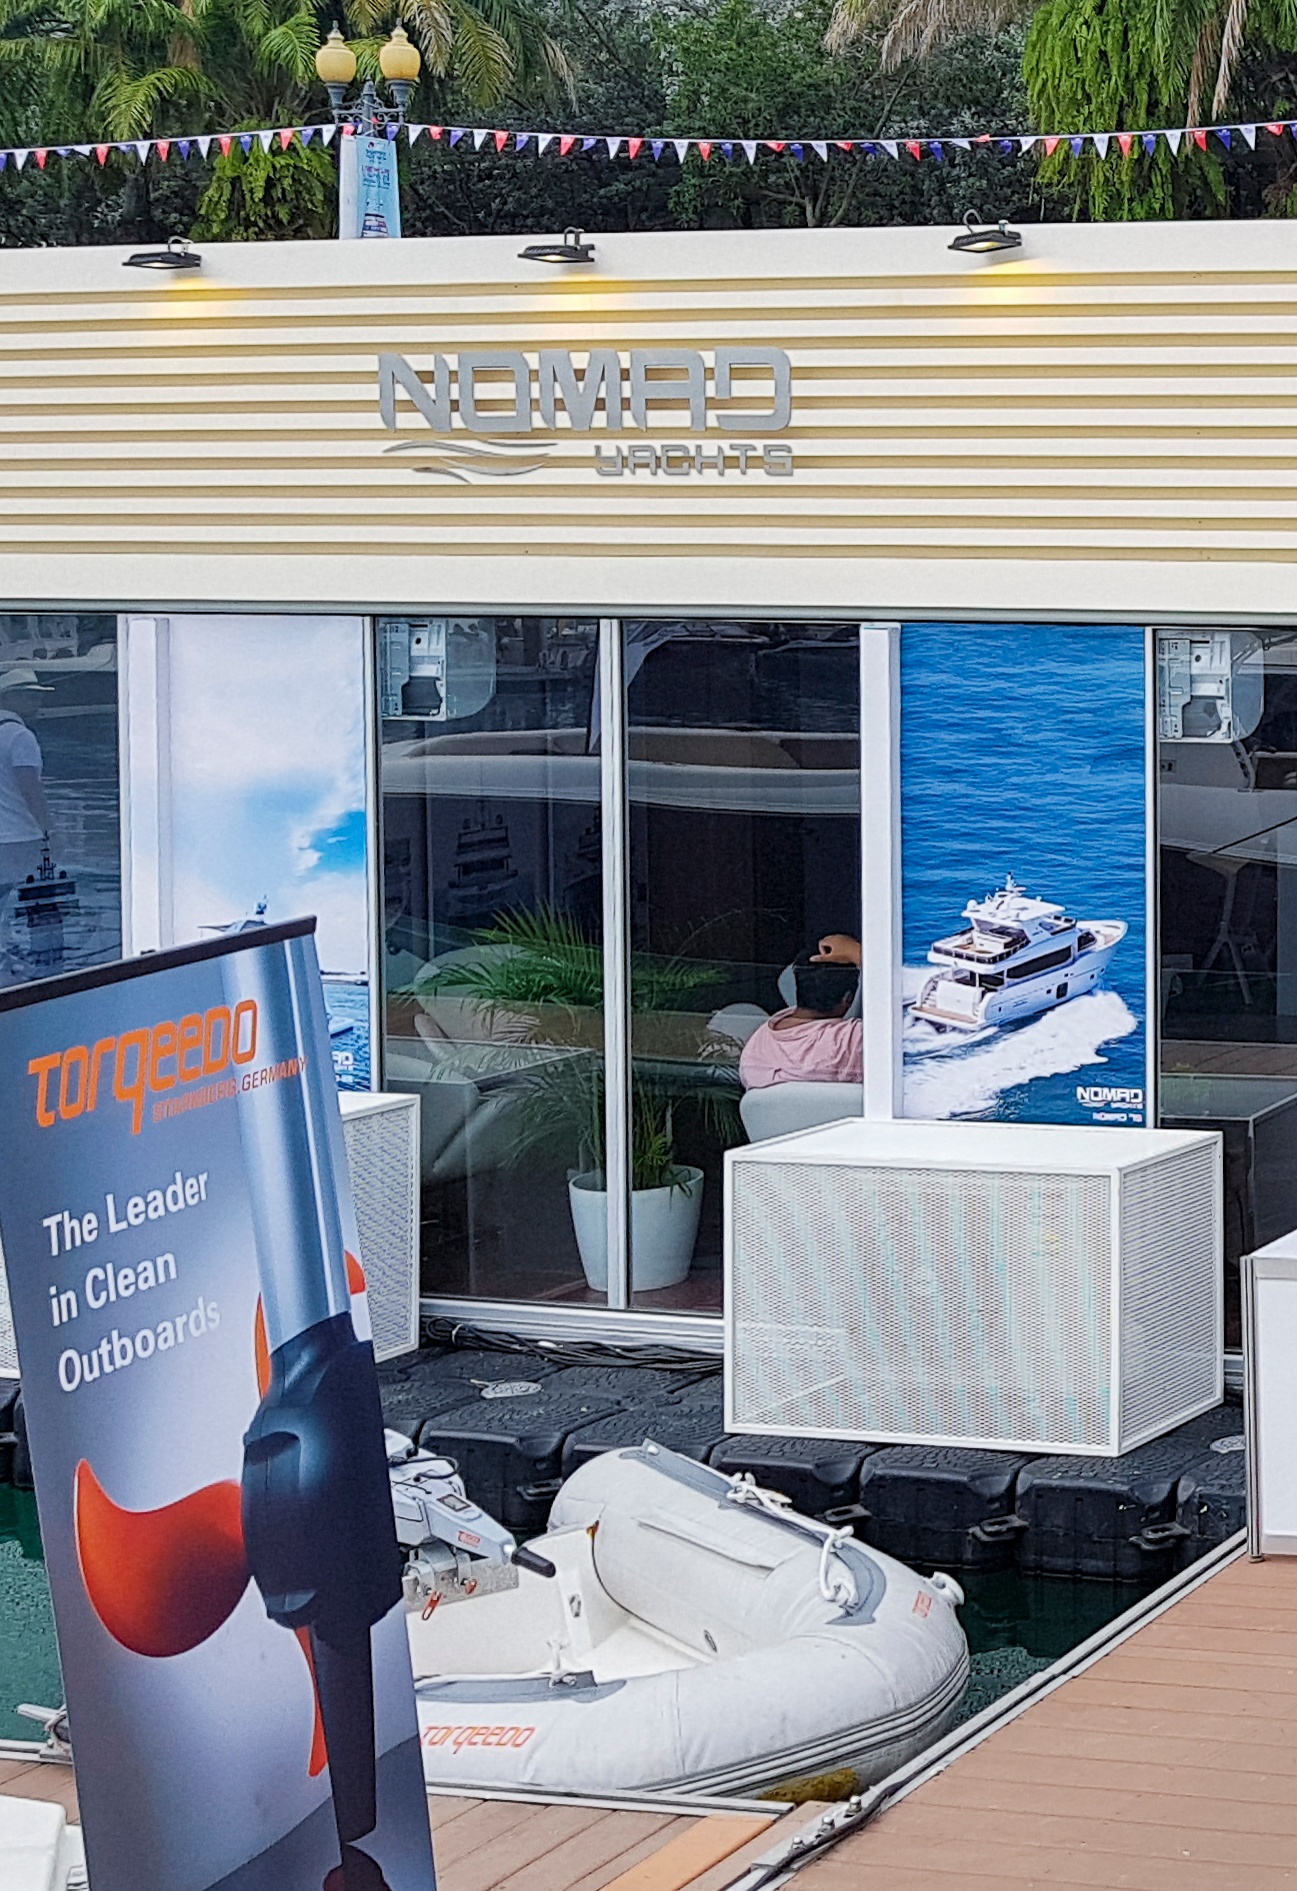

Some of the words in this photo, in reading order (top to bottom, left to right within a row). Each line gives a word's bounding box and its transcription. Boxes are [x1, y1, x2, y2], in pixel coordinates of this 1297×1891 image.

[378, 346, 792, 433] NOMAD
[594, 444, 793, 477] YACHTS
[1076, 1086, 1143, 1103] NOMAD
[42, 1210, 98, 1257] The
[105, 1171, 208, 1233] Leader
[50, 1286, 78, 1327] in
[85, 1252, 178, 1309] Clean
[58, 1296, 222, 1393] Outboards
